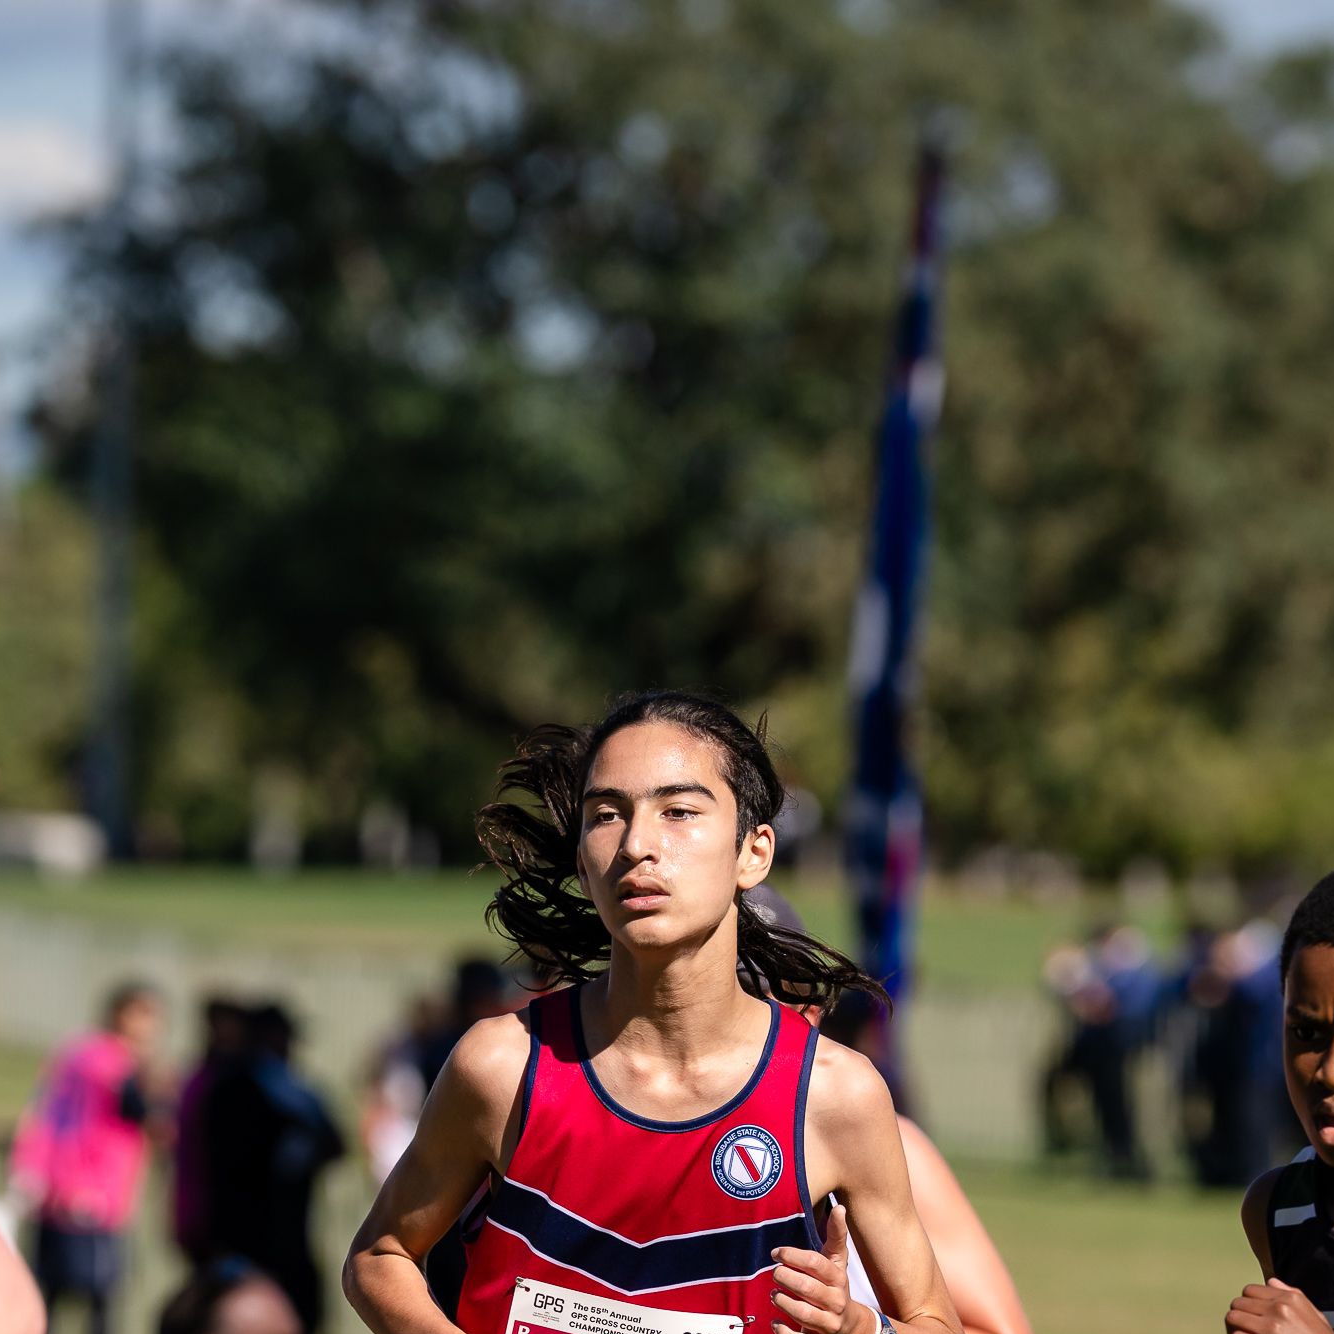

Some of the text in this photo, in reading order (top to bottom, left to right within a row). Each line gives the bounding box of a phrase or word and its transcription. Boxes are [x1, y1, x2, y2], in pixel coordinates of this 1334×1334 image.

[715, 1128, 780, 1174] BRISBANE STATE HIGH SCHOOL
[716, 1168, 736, 1193] SCIENTIA
[745, 1178, 774, 1197] POTESTAS
[533, 1292, 565, 1314] GPS
[573, 1302, 642, 1324] The 55th Annual
[570, 1311, 588, 1322] GPS
[589, 1315, 619, 1328] CROSS
